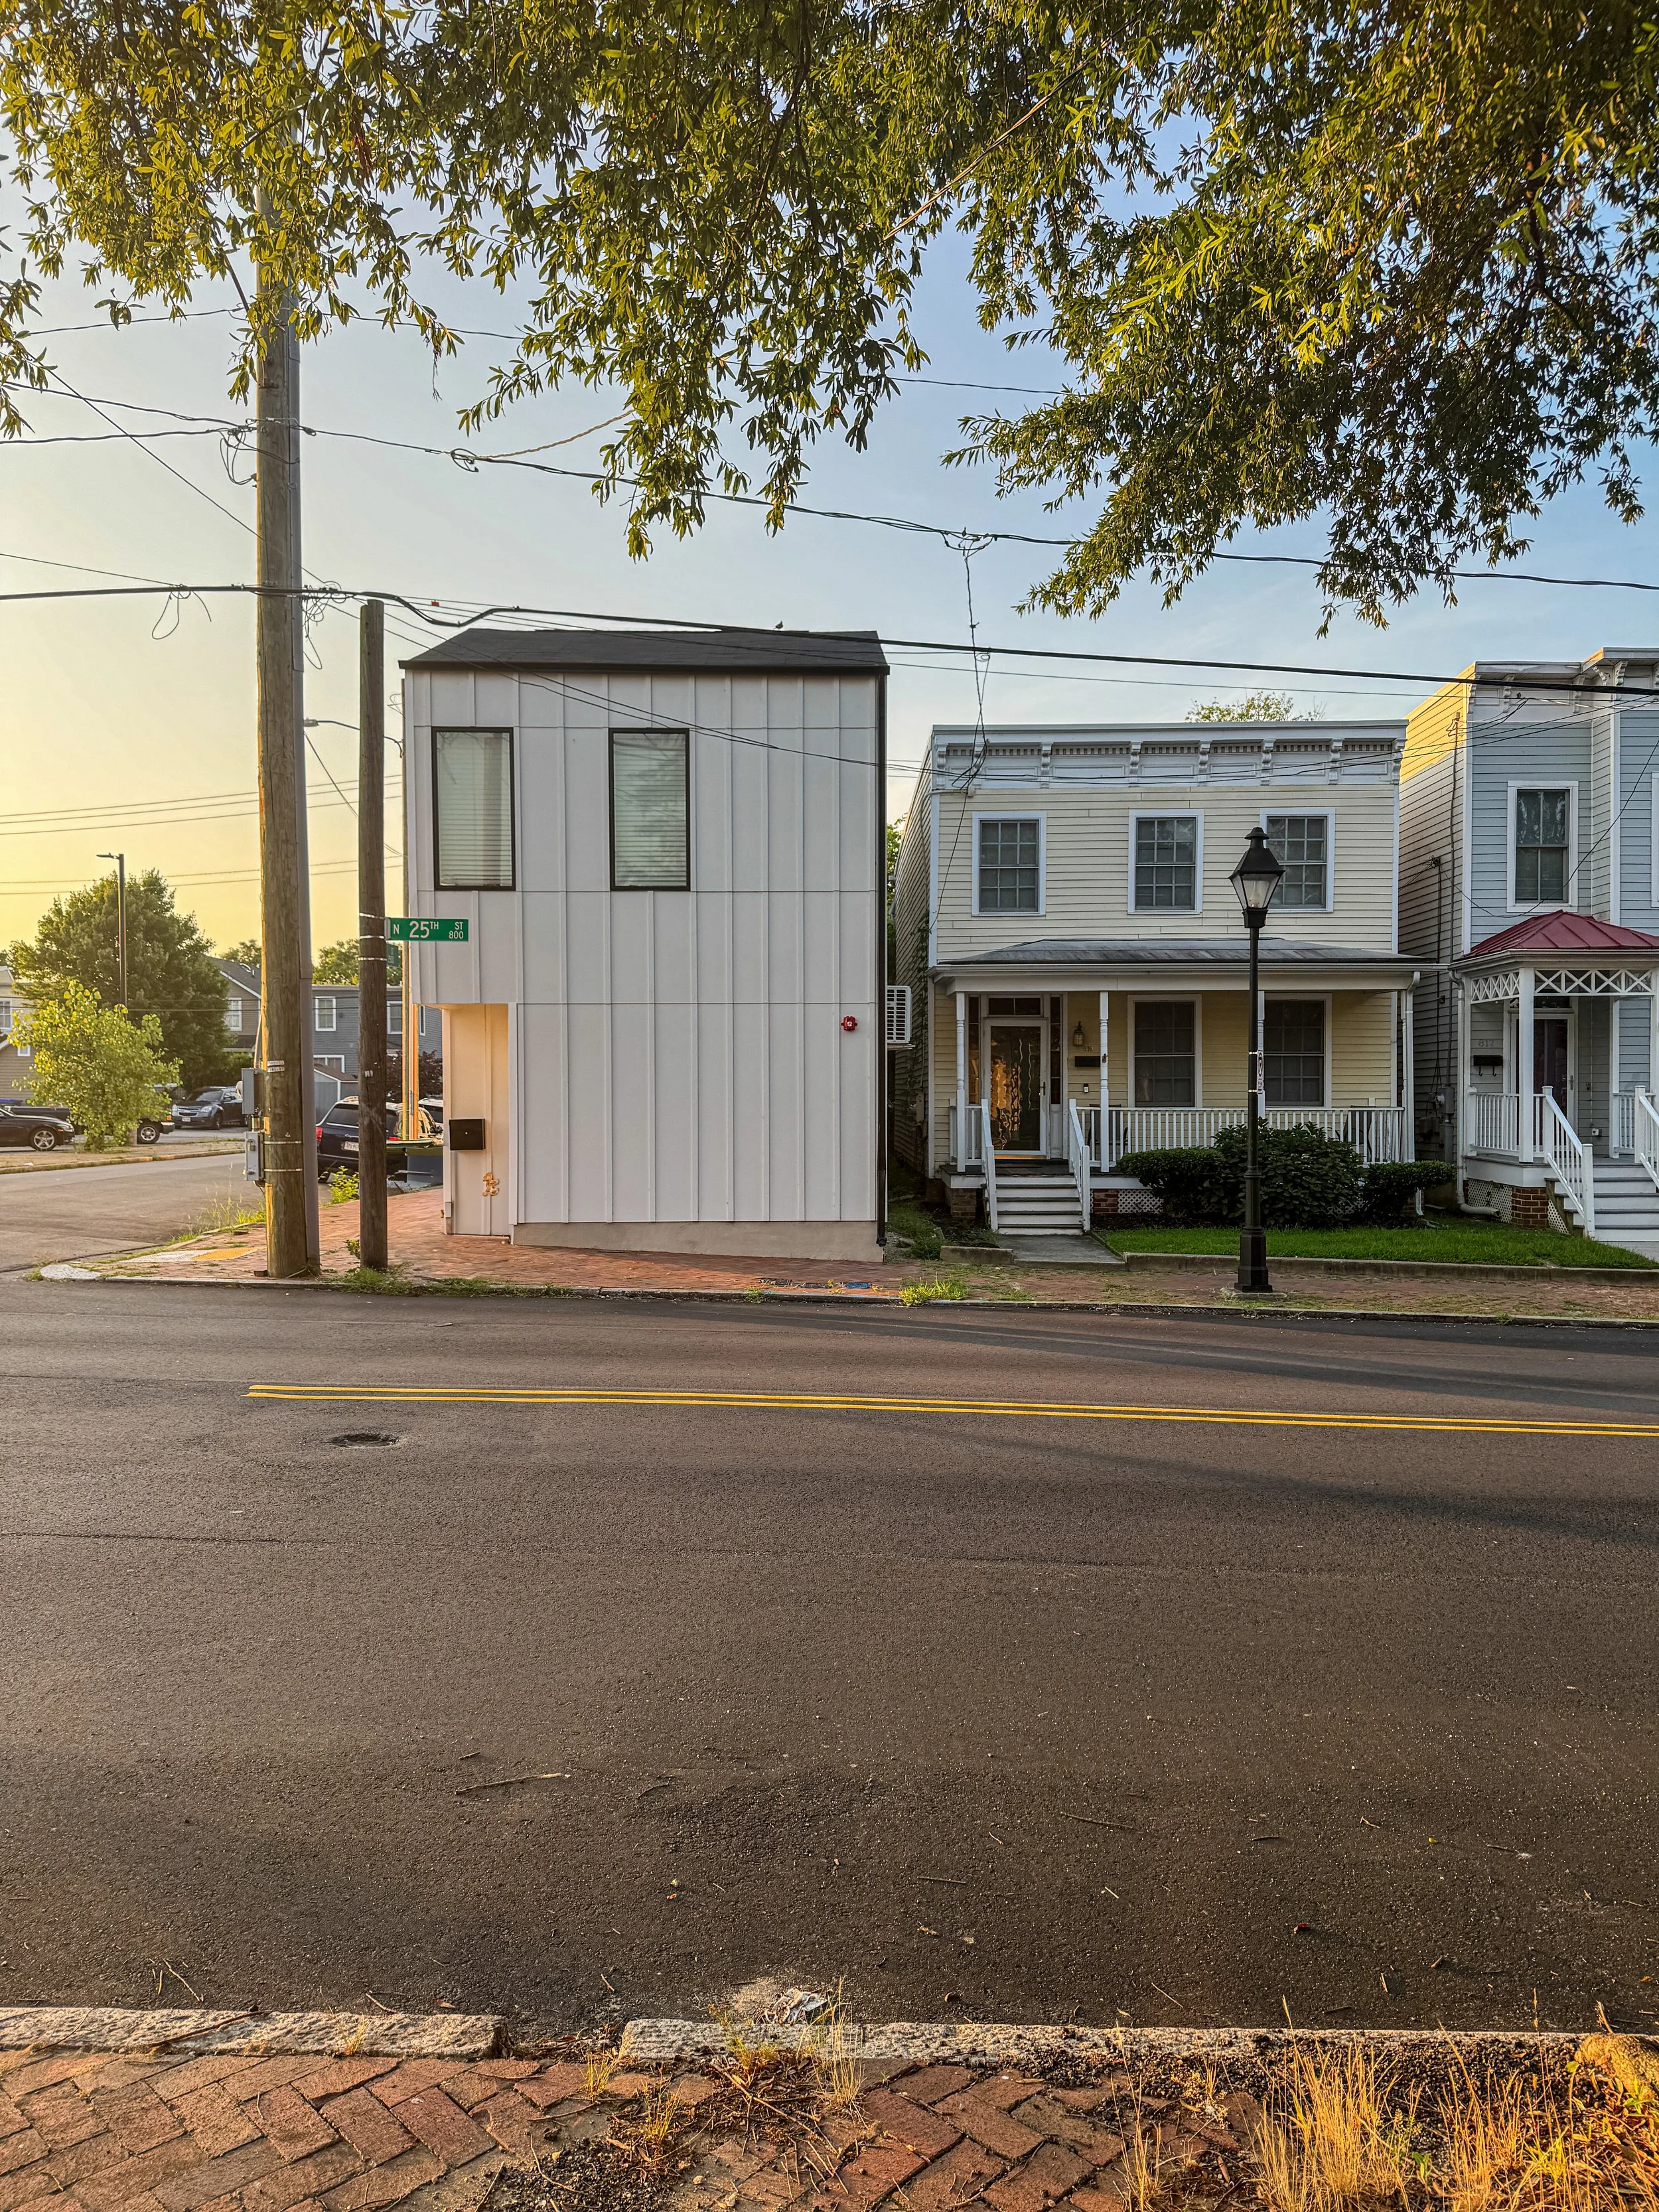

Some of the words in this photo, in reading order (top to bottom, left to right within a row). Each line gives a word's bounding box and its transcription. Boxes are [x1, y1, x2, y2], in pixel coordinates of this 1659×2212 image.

[393, 924, 399, 934] N
[409, 921, 439, 938] 25TH
[455, 921, 464, 930] ST
[449, 930, 464, 939] 800
[1478, 1039, 1494, 1047] 817
